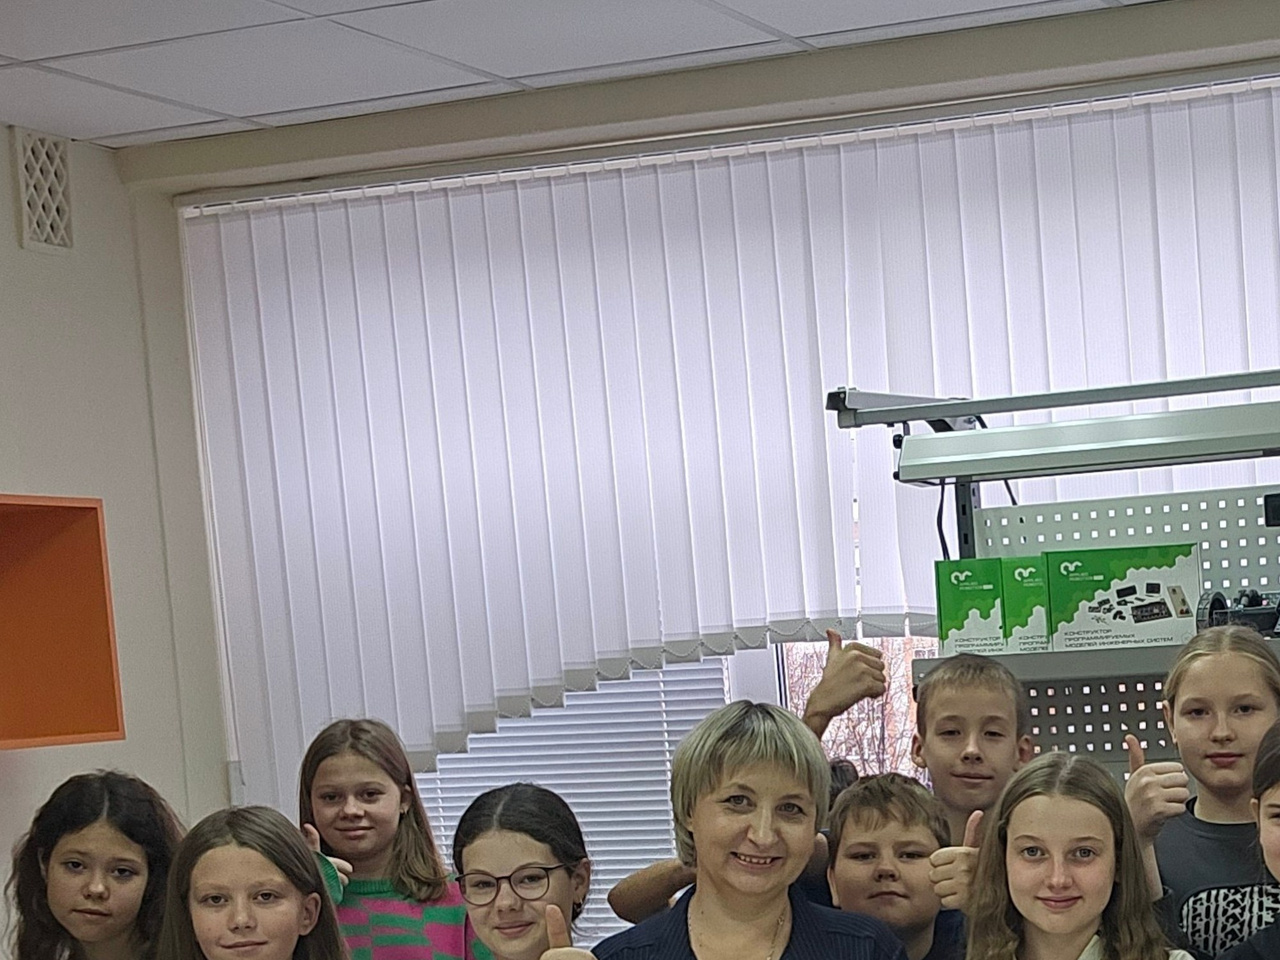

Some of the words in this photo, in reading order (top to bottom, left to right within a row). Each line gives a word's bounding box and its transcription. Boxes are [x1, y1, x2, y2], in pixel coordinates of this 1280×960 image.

[1064, 634, 1135, 642] ПРОГРАММИРУЕМЫХ
[1099, 638, 1145, 646] ИНЖЕНЕРНЫХ
[1146, 636, 1174, 644] СИСТЕМ
